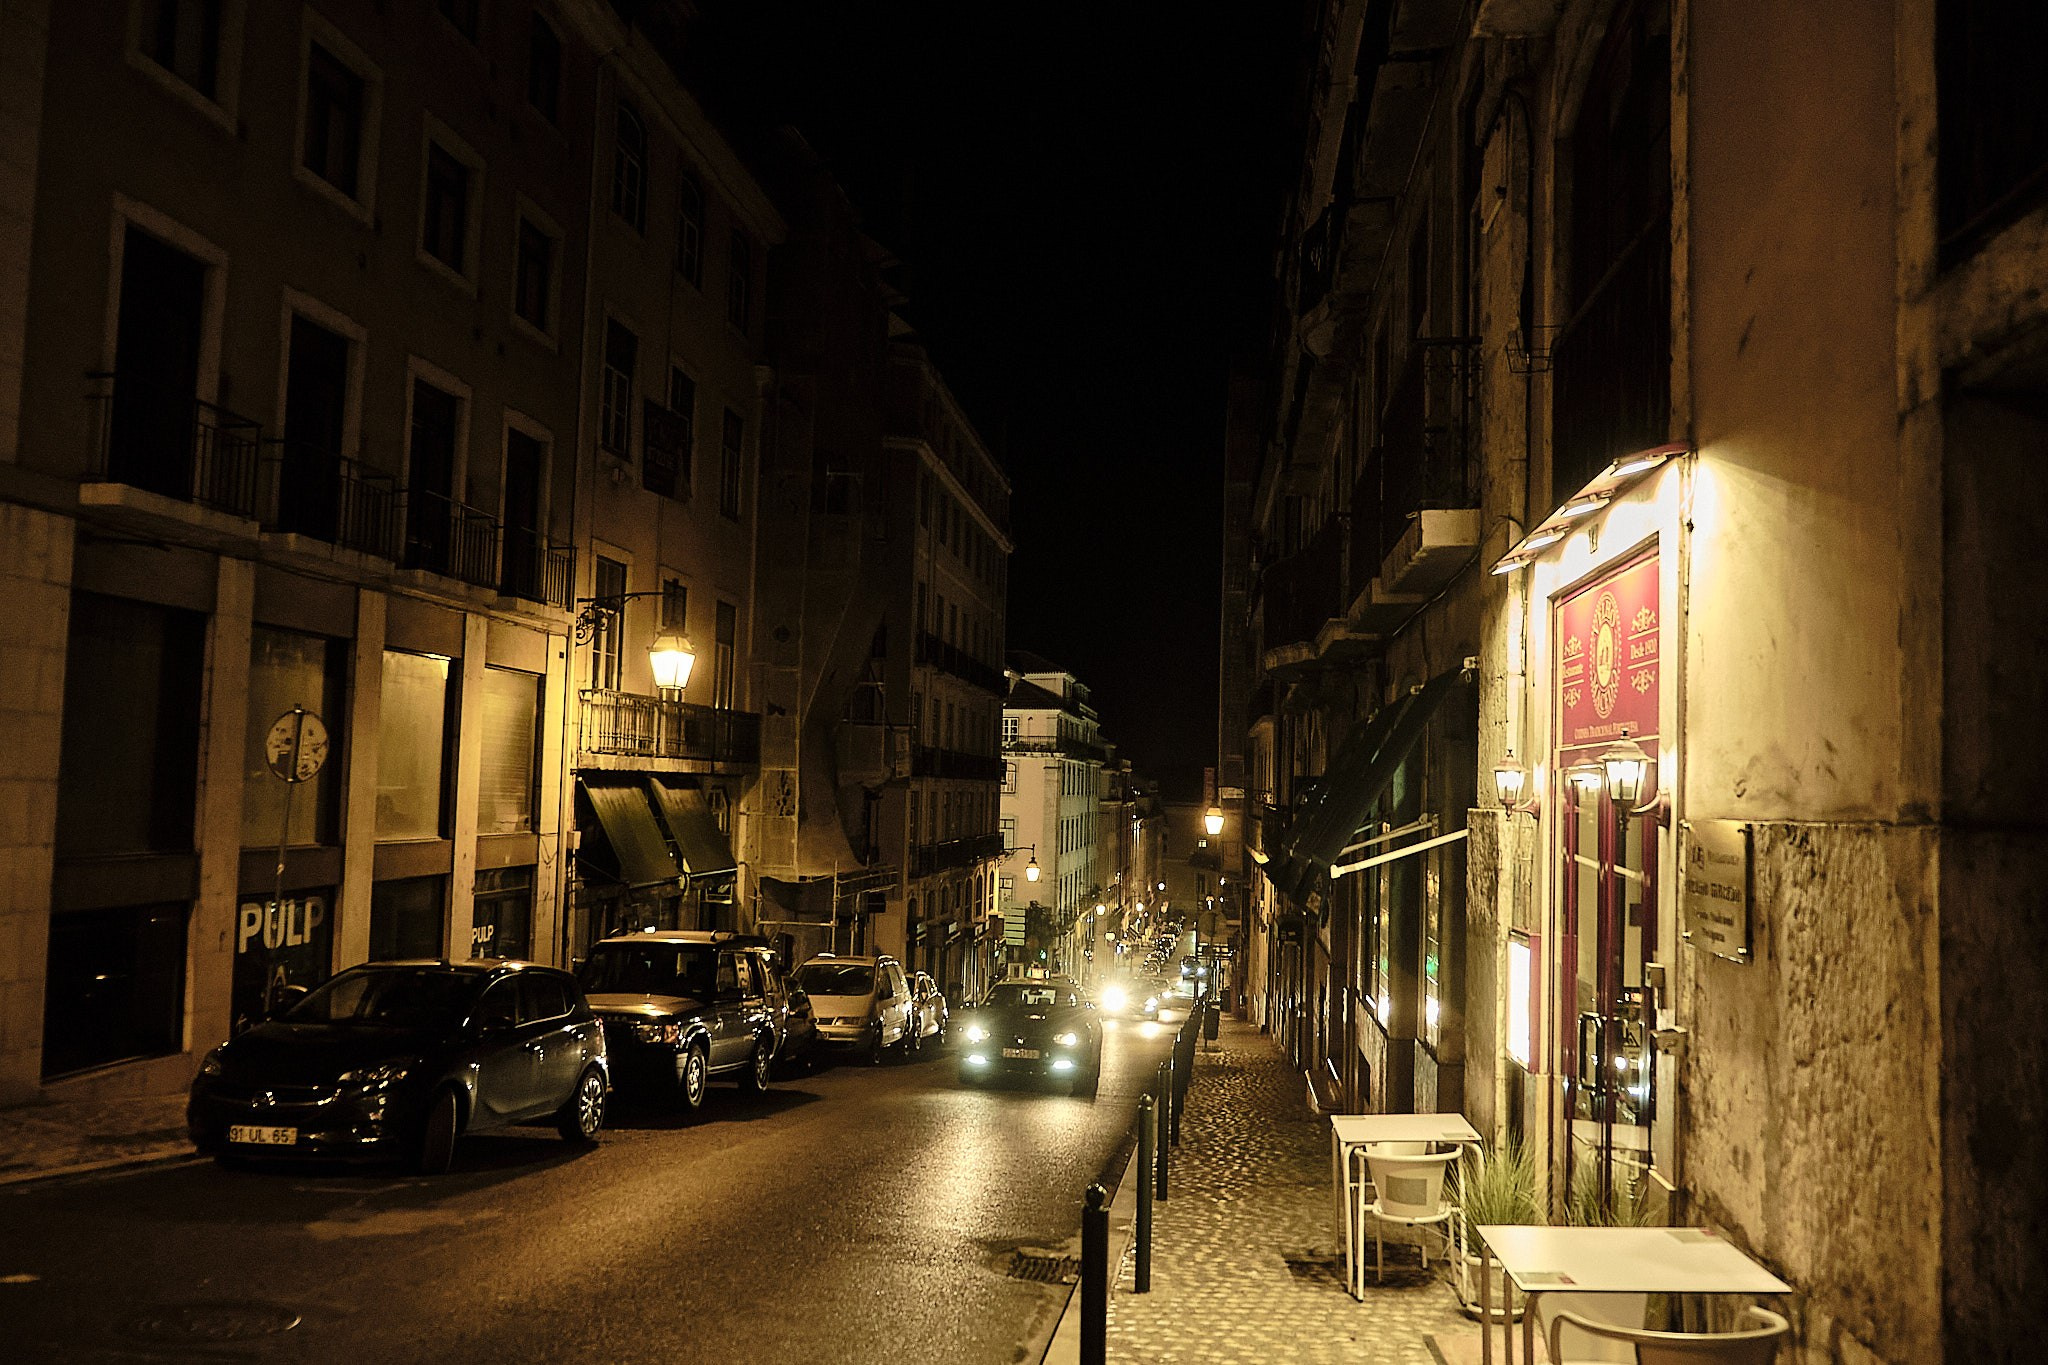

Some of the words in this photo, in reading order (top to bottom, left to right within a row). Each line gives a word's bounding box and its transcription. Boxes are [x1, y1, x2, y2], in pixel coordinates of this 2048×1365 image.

[238, 896, 324, 954] PULP
[472, 924, 494, 945] PULP
[248, 1129, 266, 1142] UL
